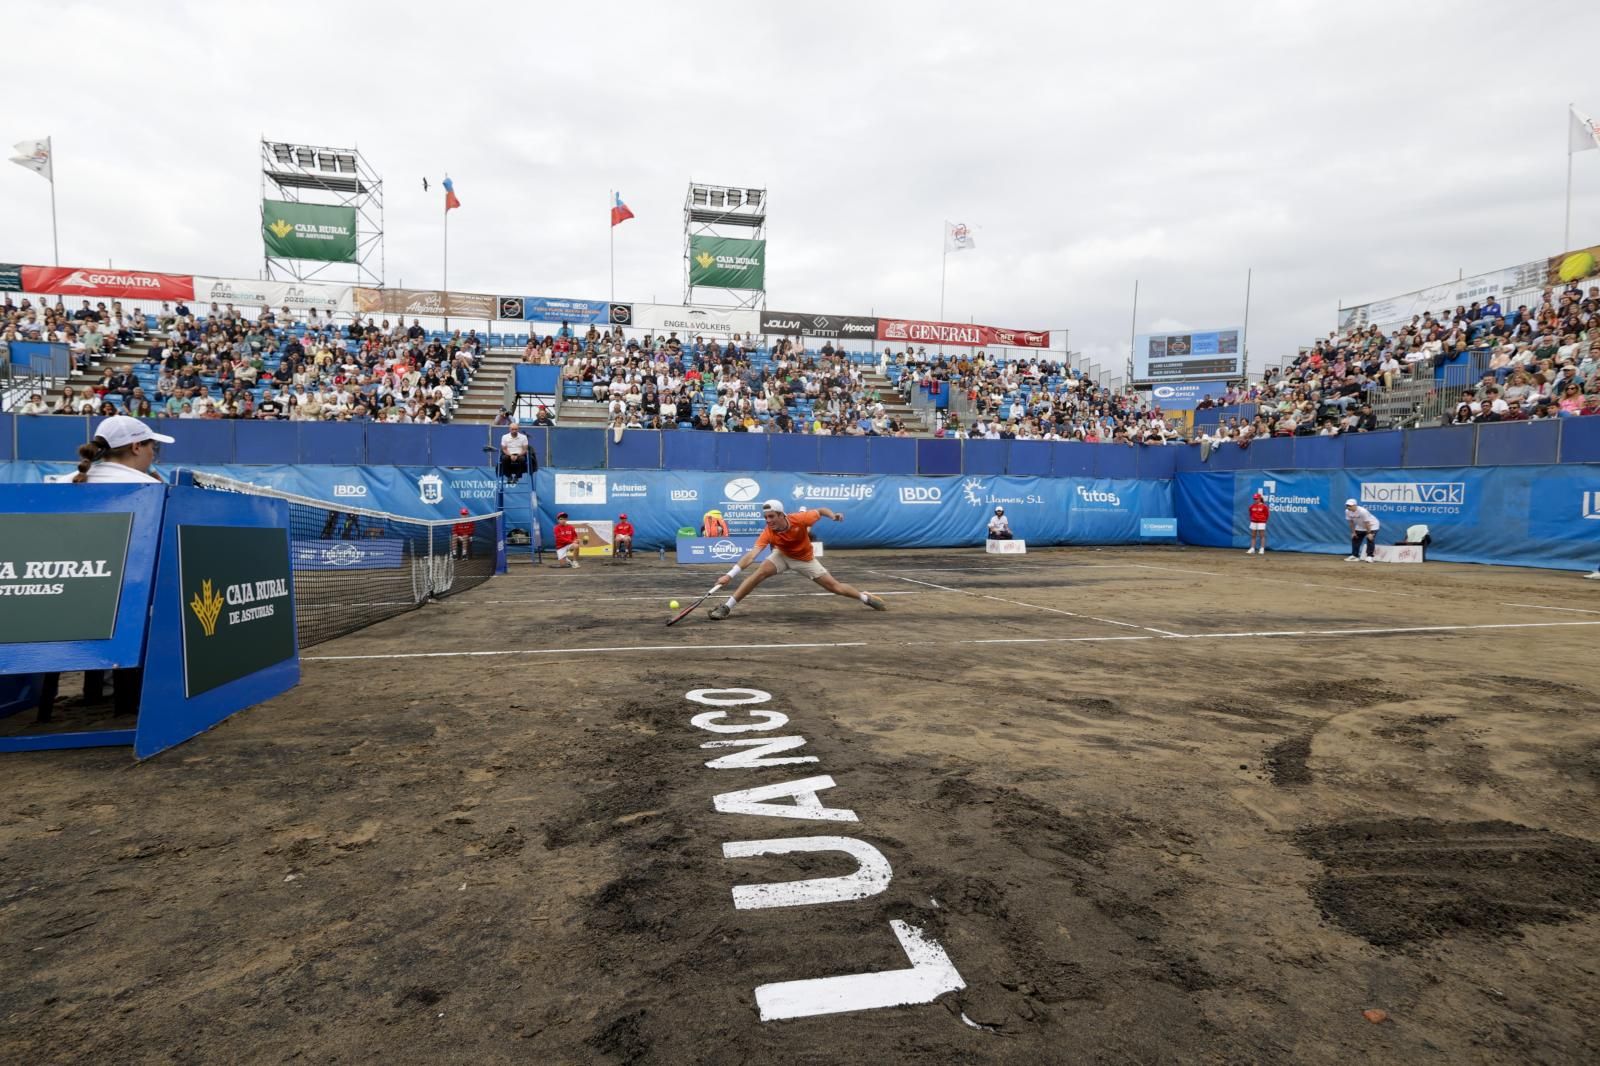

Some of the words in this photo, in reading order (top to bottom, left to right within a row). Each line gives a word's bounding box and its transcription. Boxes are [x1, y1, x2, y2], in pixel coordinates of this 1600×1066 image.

[294, 223, 318, 233] CAJA
[318, 225, 350, 236] RURAL
[716, 255, 734, 264] CAJA
[735, 256, 760, 266] RURAL
[89, 274, 161, 288] GOZNATRA
[763, 319, 801, 330] JOLUVI
[909, 324, 980, 343] GENERALI
[460, 490, 471, 499] DE
[674, 490, 698, 499] BDO
[806, 484, 873, 500] tennislife
[1082, 490, 1116, 503] titos
[1268, 494, 1320, 505] Recruitment
[1268, 503, 1308, 513] Solutions
[1409, 506, 1460, 514] PROYECTOS
[0, 561, 18, 580] A
[23, 559, 112, 579] RURAL
[226, 582, 256, 606] CAJA
[255, 578, 289, 600] RURAL
[228, 610, 241, 625] DE
[240, 604, 275, 623] ASTURIAS
[685, 687, 968, 1022] LUANCO
